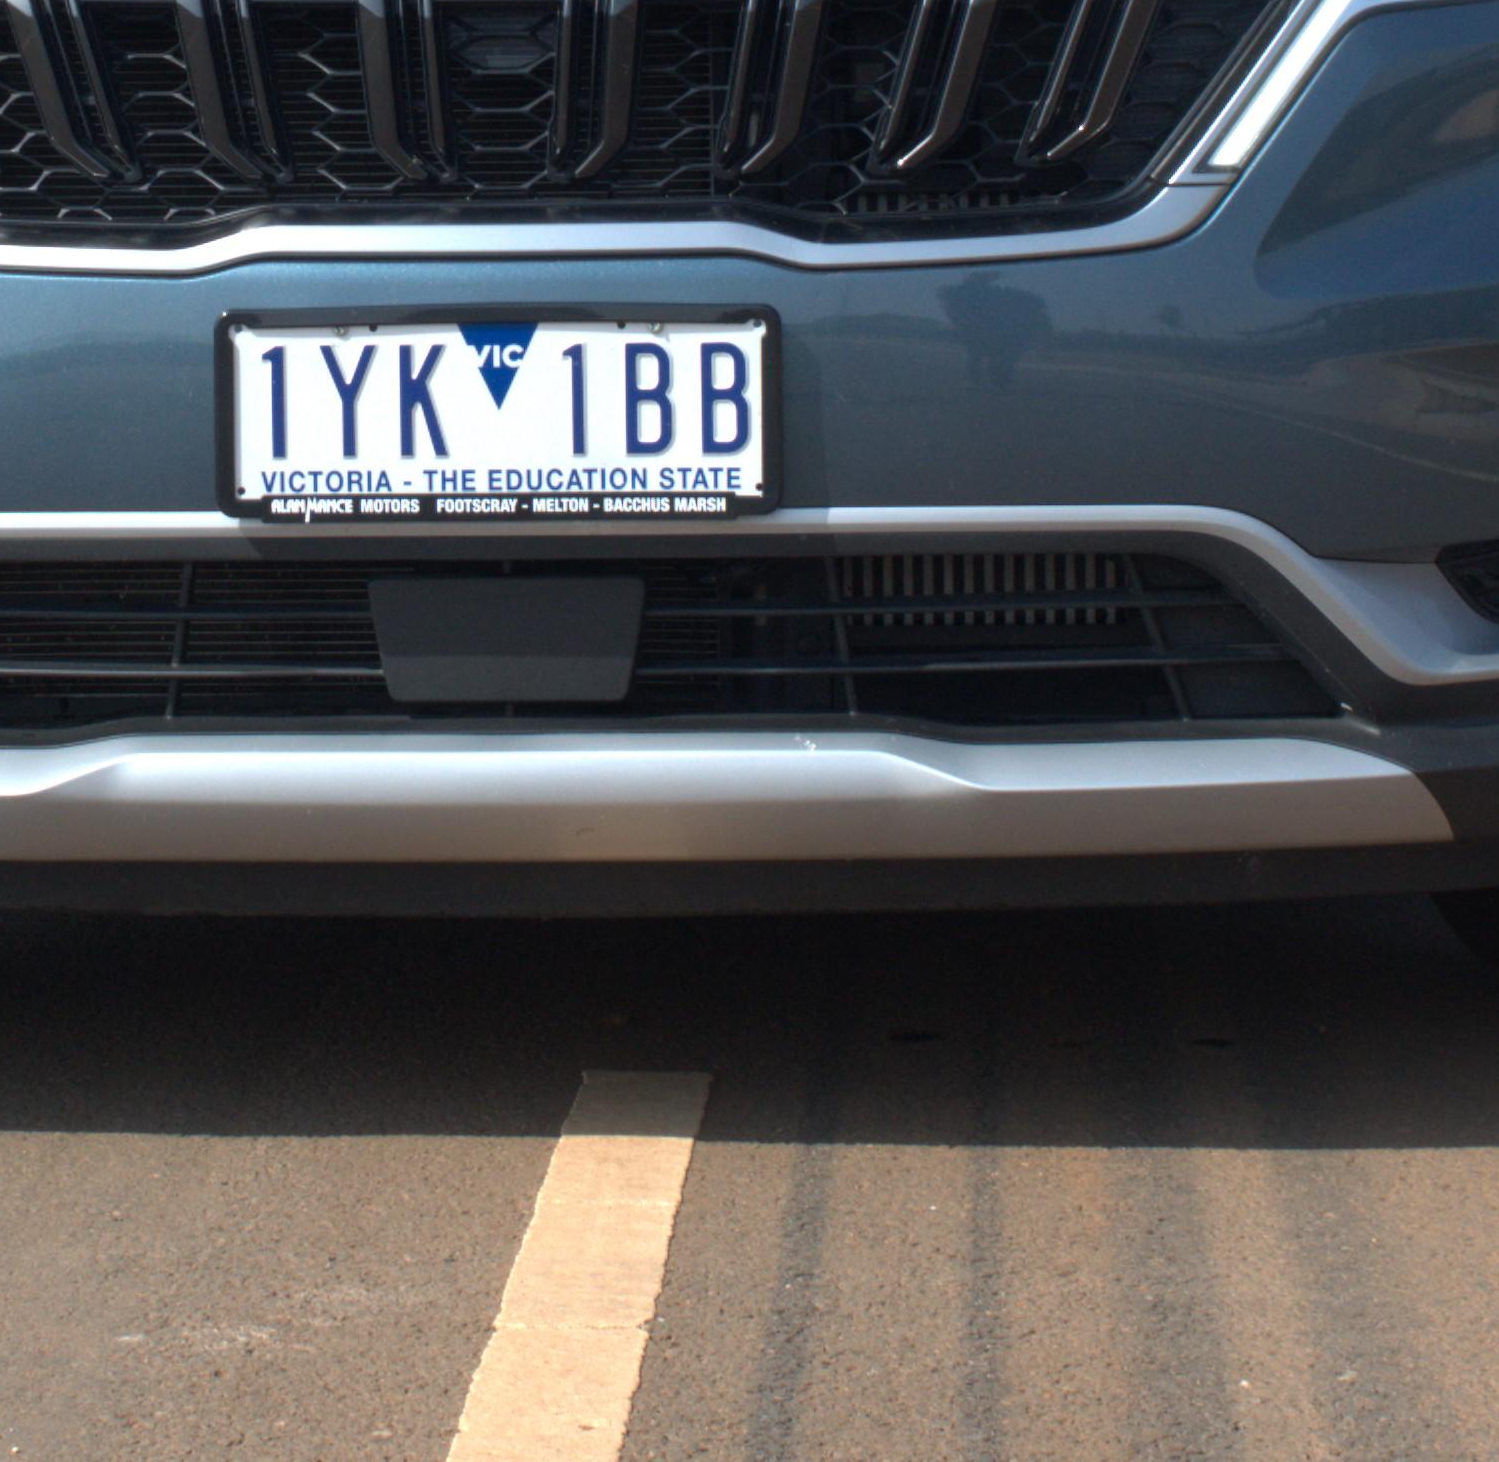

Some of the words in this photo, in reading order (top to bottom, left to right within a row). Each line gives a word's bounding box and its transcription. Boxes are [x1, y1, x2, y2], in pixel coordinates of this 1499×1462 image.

[466, 344, 524, 368] VIC
[262, 344, 449, 459] 1YK
[562, 342, 751, 456] 1BB
[261, 471, 392, 492] VICTORIA
[423, 469, 476, 492] THE
[488, 468, 647, 491] EDUCATION
[659, 467, 742, 490] STATE
[360, 498, 420, 514] MOTORS
[436, 498, 518, 514] FOOTSCRAY
[532, 497, 589, 513] MELTON
[603, 497, 670, 513] BACCHUS
[674, 496, 727, 513] MARSH
